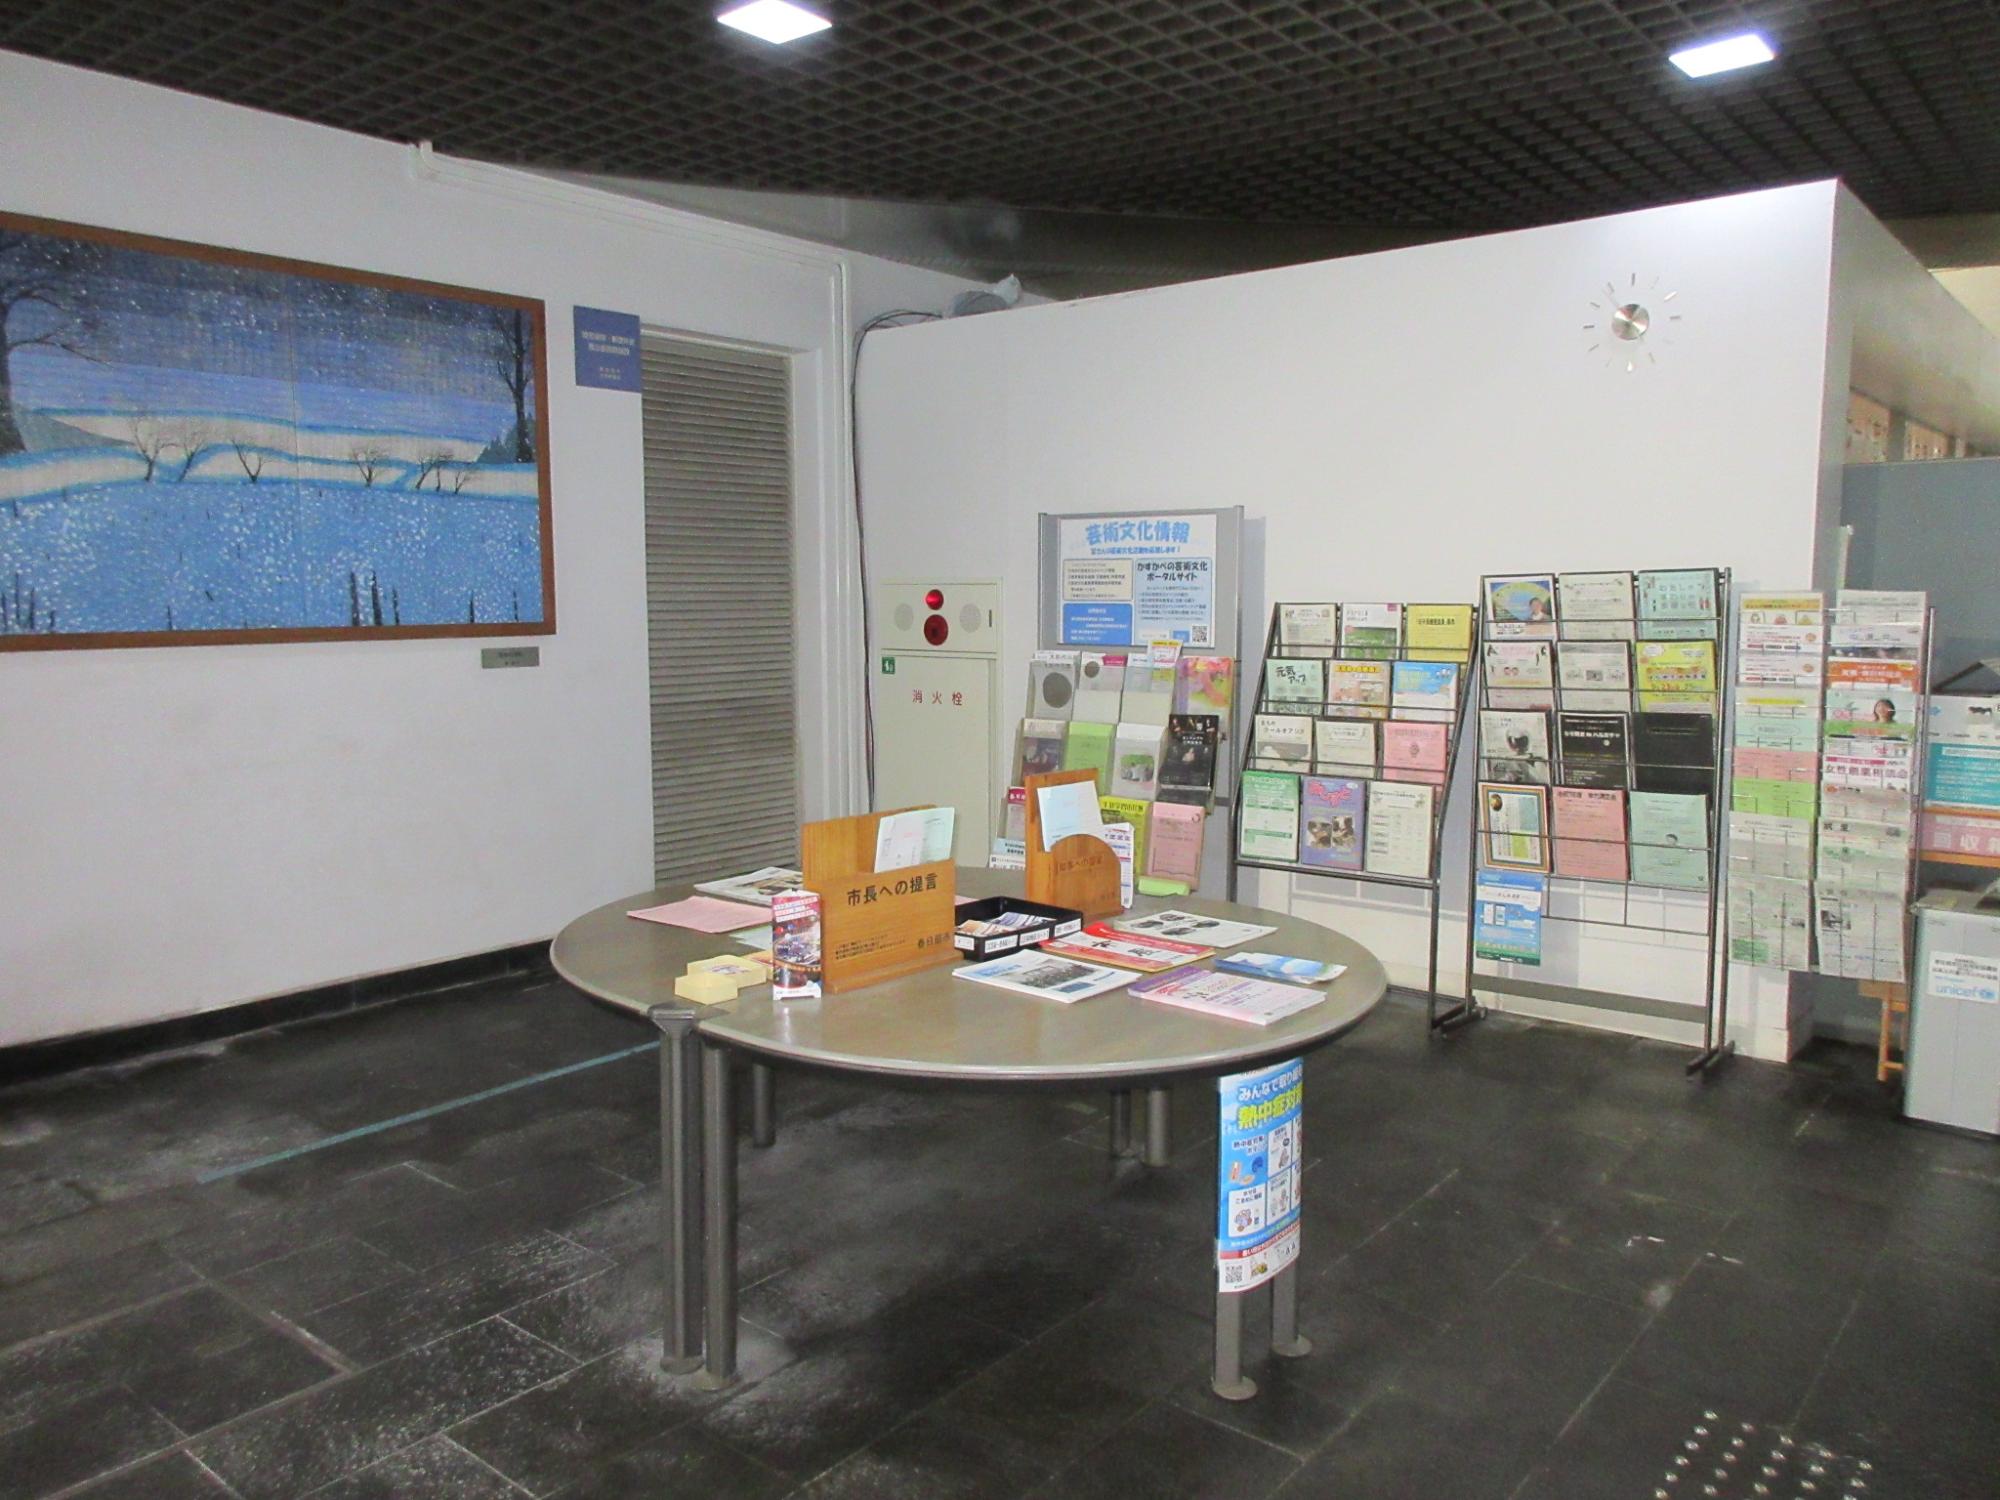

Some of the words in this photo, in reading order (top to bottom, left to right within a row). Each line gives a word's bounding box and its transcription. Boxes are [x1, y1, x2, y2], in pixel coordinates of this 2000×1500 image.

[1085, 520, 1190, 545] 芸術文化情報
[1137, 561, 1208, 571] かすかべの芸術文化
[1147, 572, 1197, 581] ポータルサイト
[912, 689, 963, 706] 消火栓
[847, 872, 938, 906] 市長への提言
